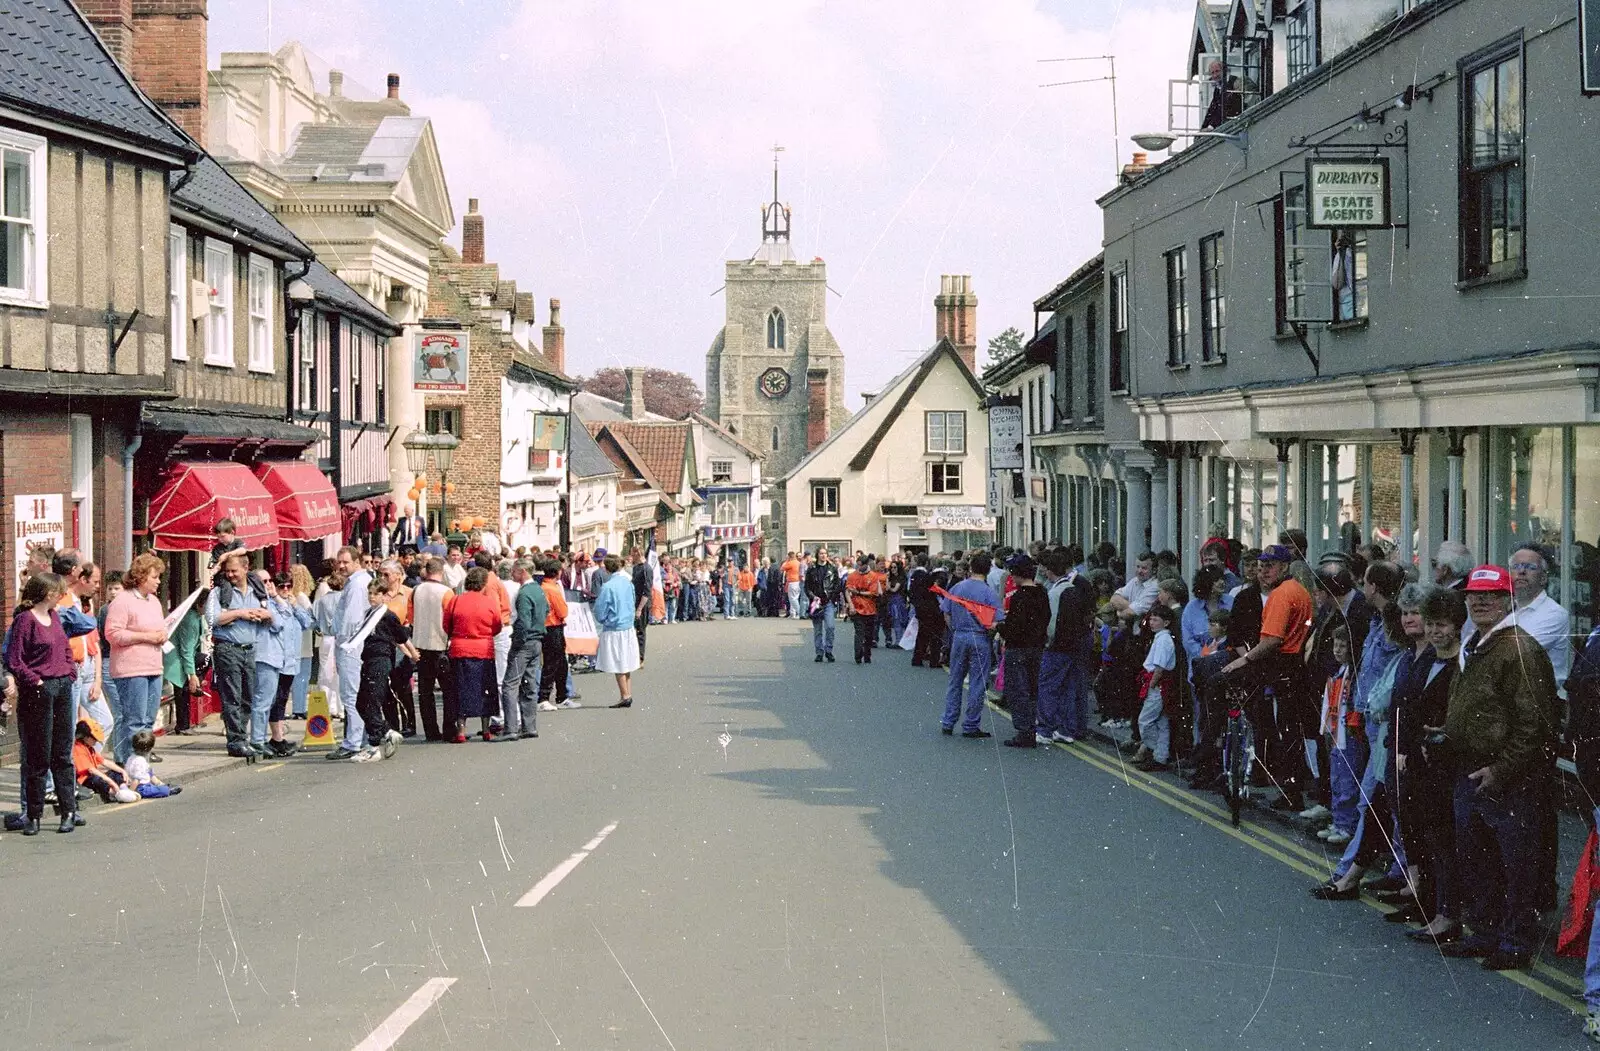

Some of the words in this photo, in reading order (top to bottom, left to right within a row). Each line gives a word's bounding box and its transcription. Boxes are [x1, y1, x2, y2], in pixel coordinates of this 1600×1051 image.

[1322, 196, 1374, 208] ESTATE
[1323, 209, 1374, 221] AGENTS
[936, 516, 983, 528] CHAMPIONS
[16, 521, 63, 538] HAMILTON
